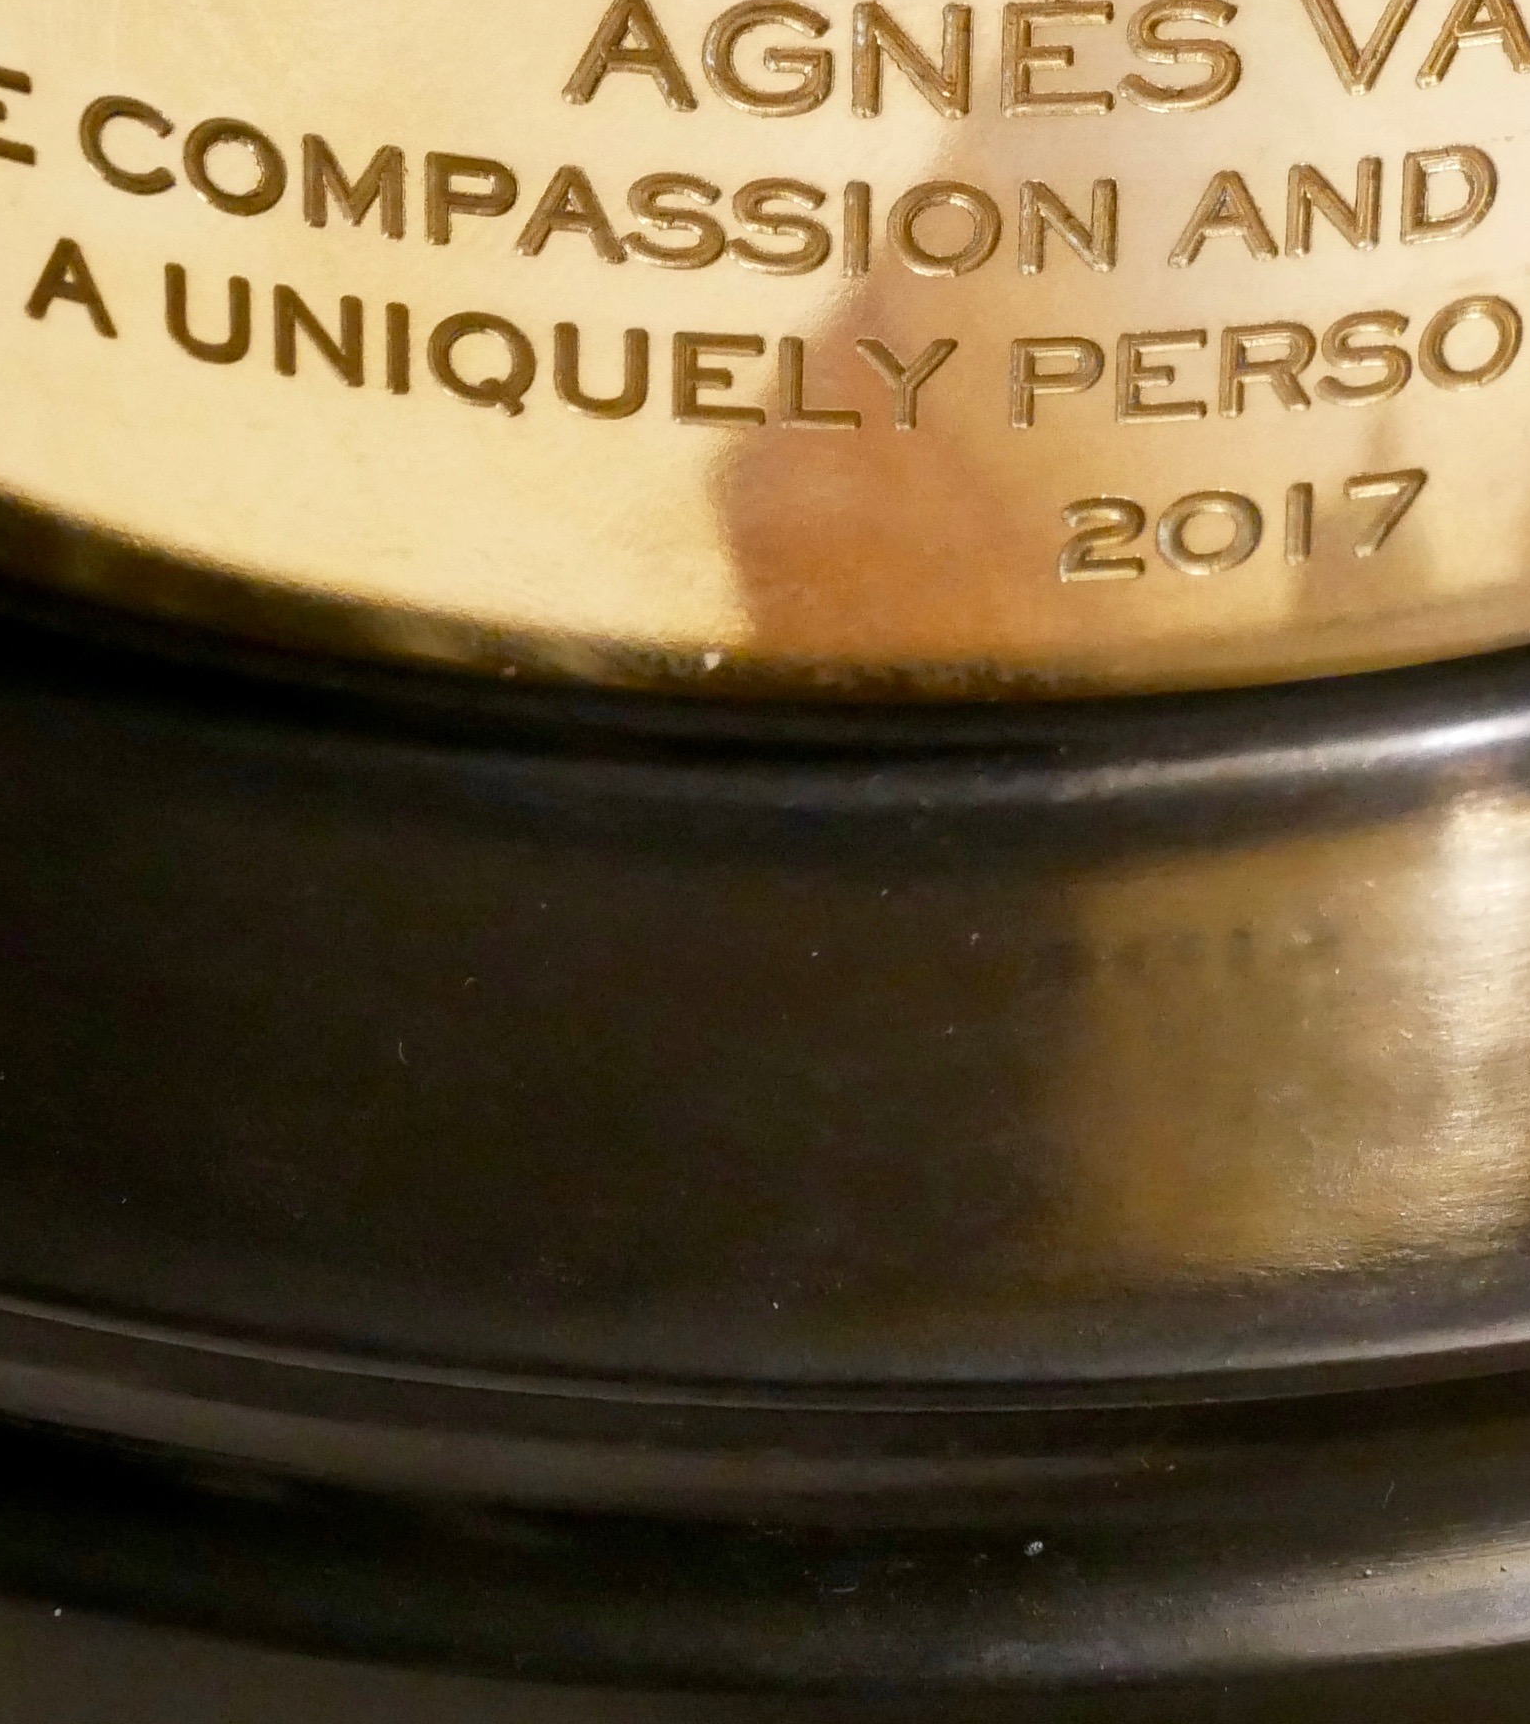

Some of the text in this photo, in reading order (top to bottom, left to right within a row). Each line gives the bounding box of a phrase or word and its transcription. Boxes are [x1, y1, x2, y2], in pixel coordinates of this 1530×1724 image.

[78, 93, 1119, 278] COMPASSION
[1166, 144, 1498, 268] AND
[24, 236, 118, 339] A
[164, 261, 959, 431] UNIQUELY
[1058, 467, 1429, 584] 2017
